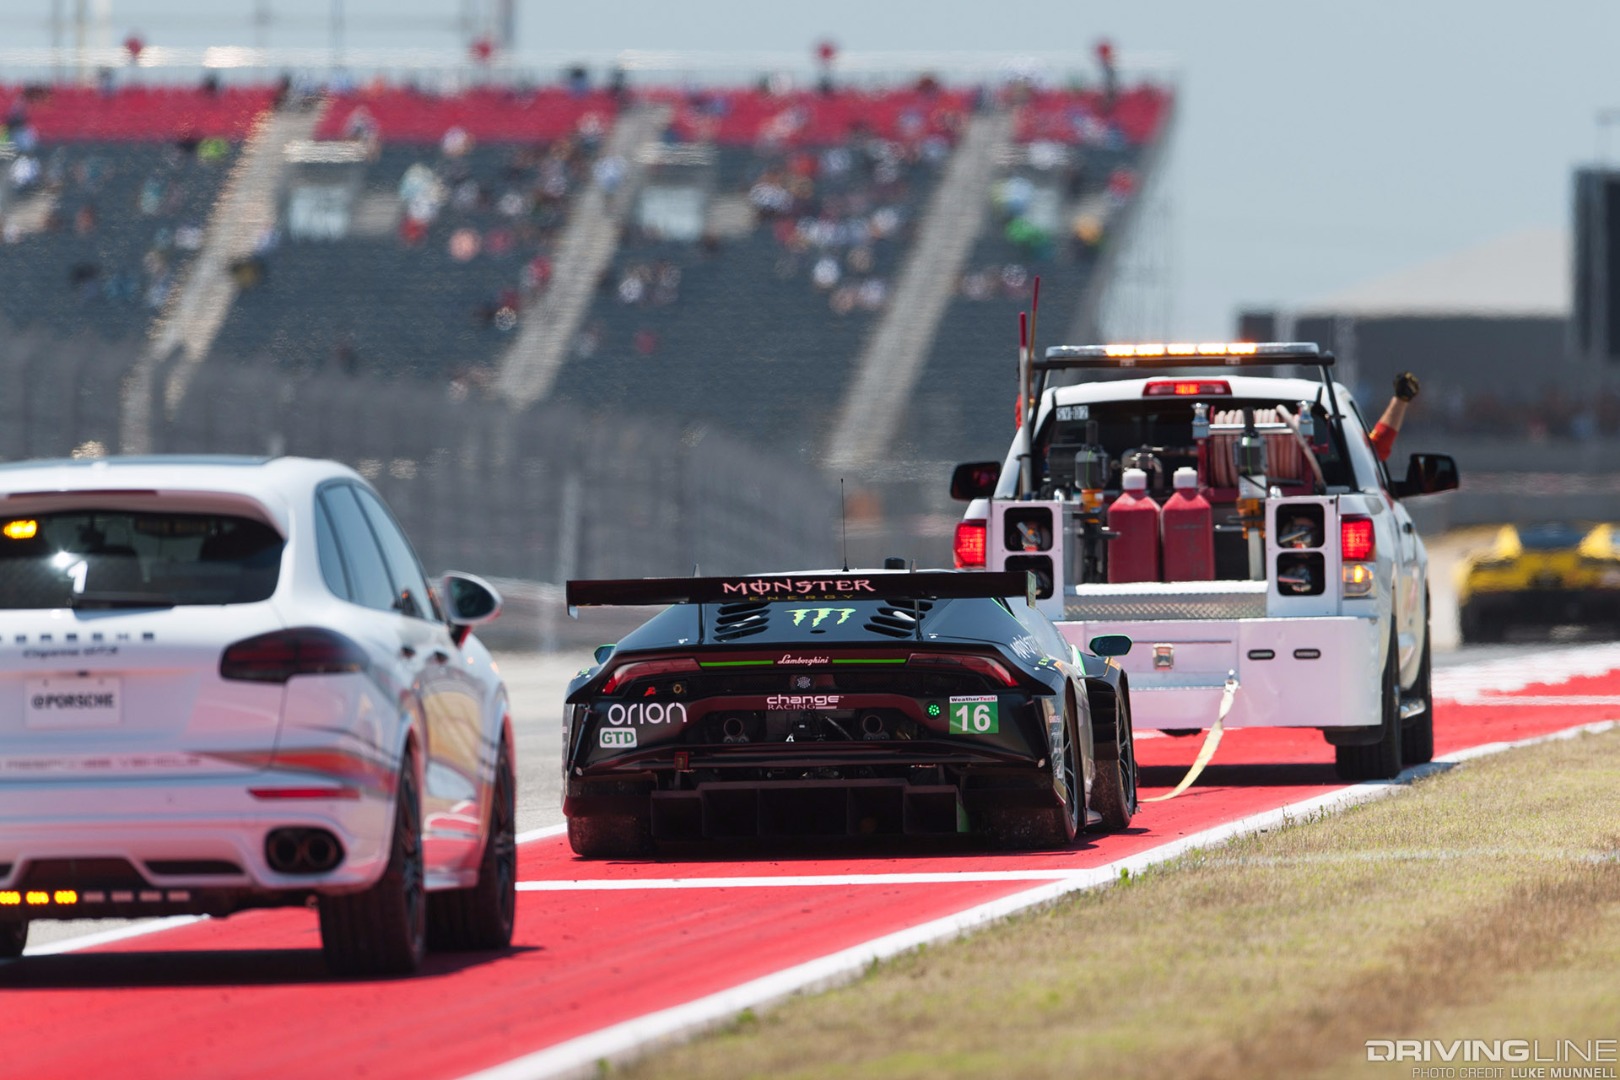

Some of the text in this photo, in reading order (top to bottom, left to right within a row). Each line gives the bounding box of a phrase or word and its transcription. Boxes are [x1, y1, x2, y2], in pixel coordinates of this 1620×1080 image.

[722, 578, 876, 596] MONSTER
[777, 654, 830, 667] Lamborghini
[32, 693, 115, 710] @PORSCHE
[767, 694, 840, 706] change
[956, 704, 991, 732] 16
[601, 731, 635, 745] GTD
